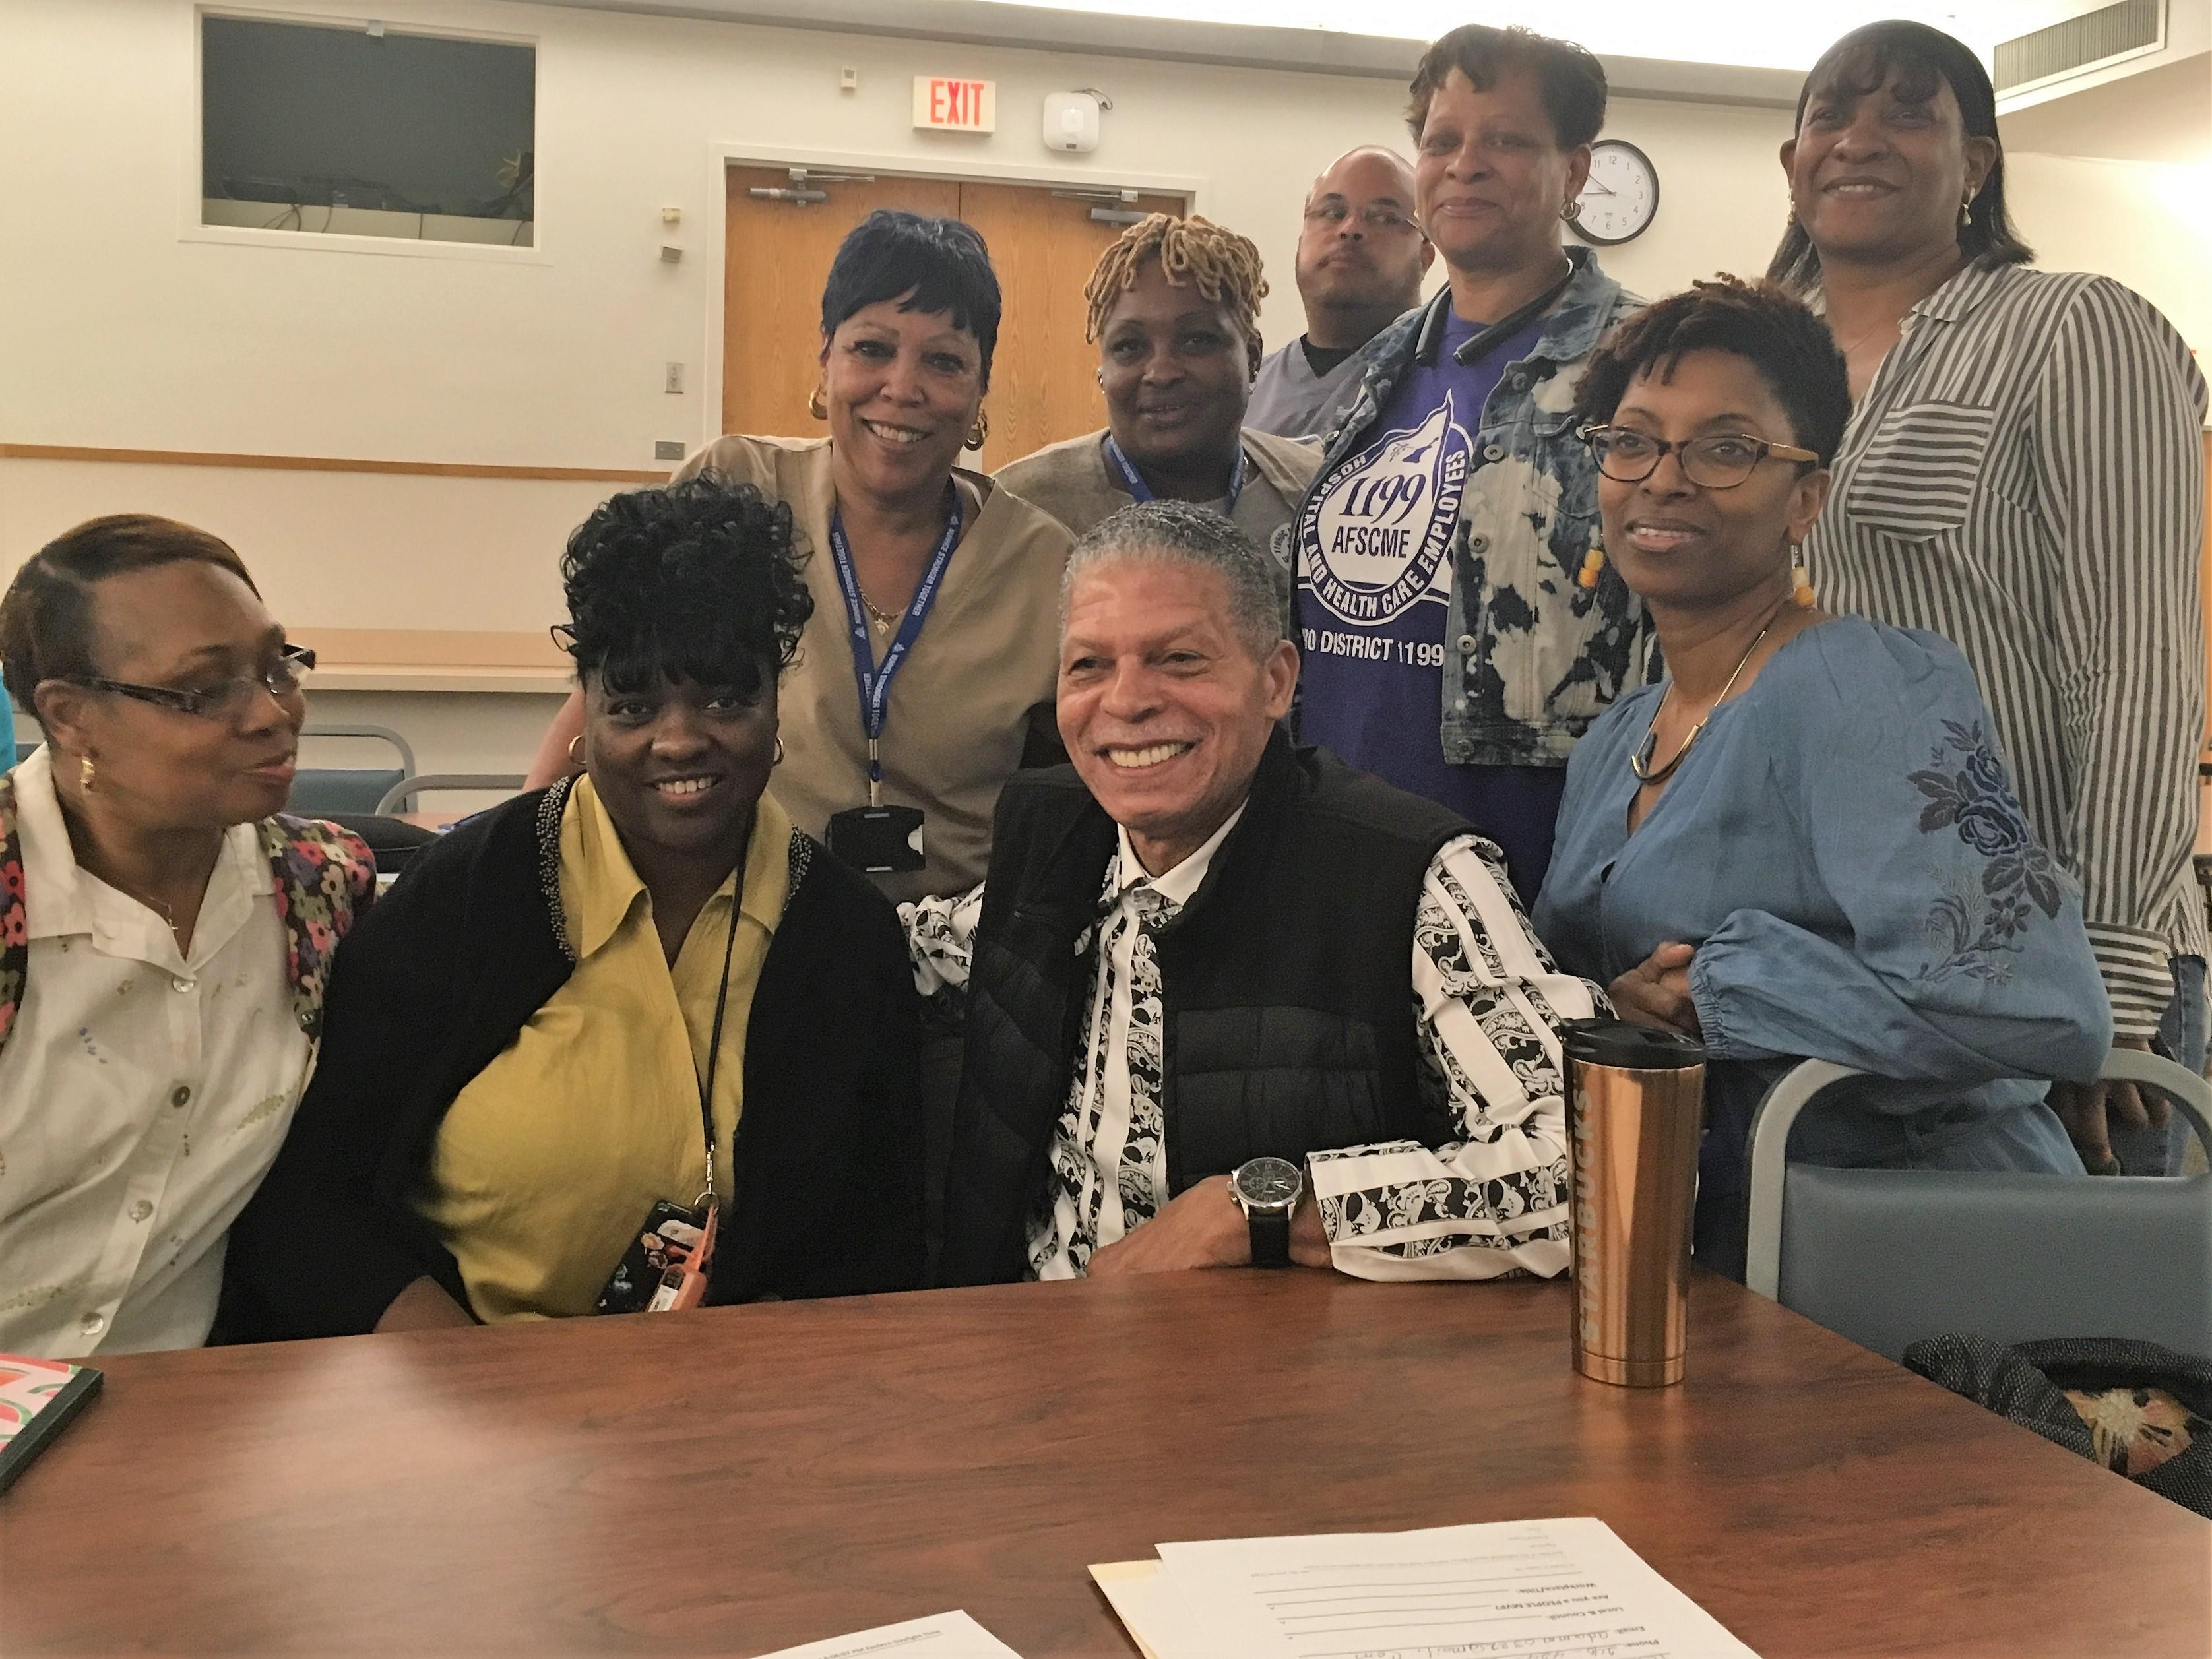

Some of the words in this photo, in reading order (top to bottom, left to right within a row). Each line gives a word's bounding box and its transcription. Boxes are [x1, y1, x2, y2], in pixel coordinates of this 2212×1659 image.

[930, 80, 984, 126] EXIT
[1594, 160, 1601, 168] 11
[1608, 156, 1618, 165] 12
[1635, 175, 1641, 185] 2
[1639, 191, 1644, 200] 3
[1581, 202, 1586, 210] 8
[1591, 215, 1596, 224] 7
[1622, 217, 1627, 226] 5
[1633, 206, 1639, 214] 4
[1605, 221, 1611, 230] 6
[1301, 454, 1366, 538] HOSPITAL
[1338, 473, 1426, 525] 1199
[1419, 449, 1465, 575] EMPLOYEES
[1331, 525, 1411, 559] AFSCME
[926, 551, 945, 585] STRONGER
[1306, 543, 1325, 584] AND
[911, 584, 932, 617] TOGETHER
[1323, 580, 1377, 617] HEALTH
[1381, 569, 1425, 613] CARE
[1320, 631, 1393, 662] DISTRICT
[1397, 641, 1445, 667] 1199
[1572, 1088, 1600, 1344] STARBUCKS
